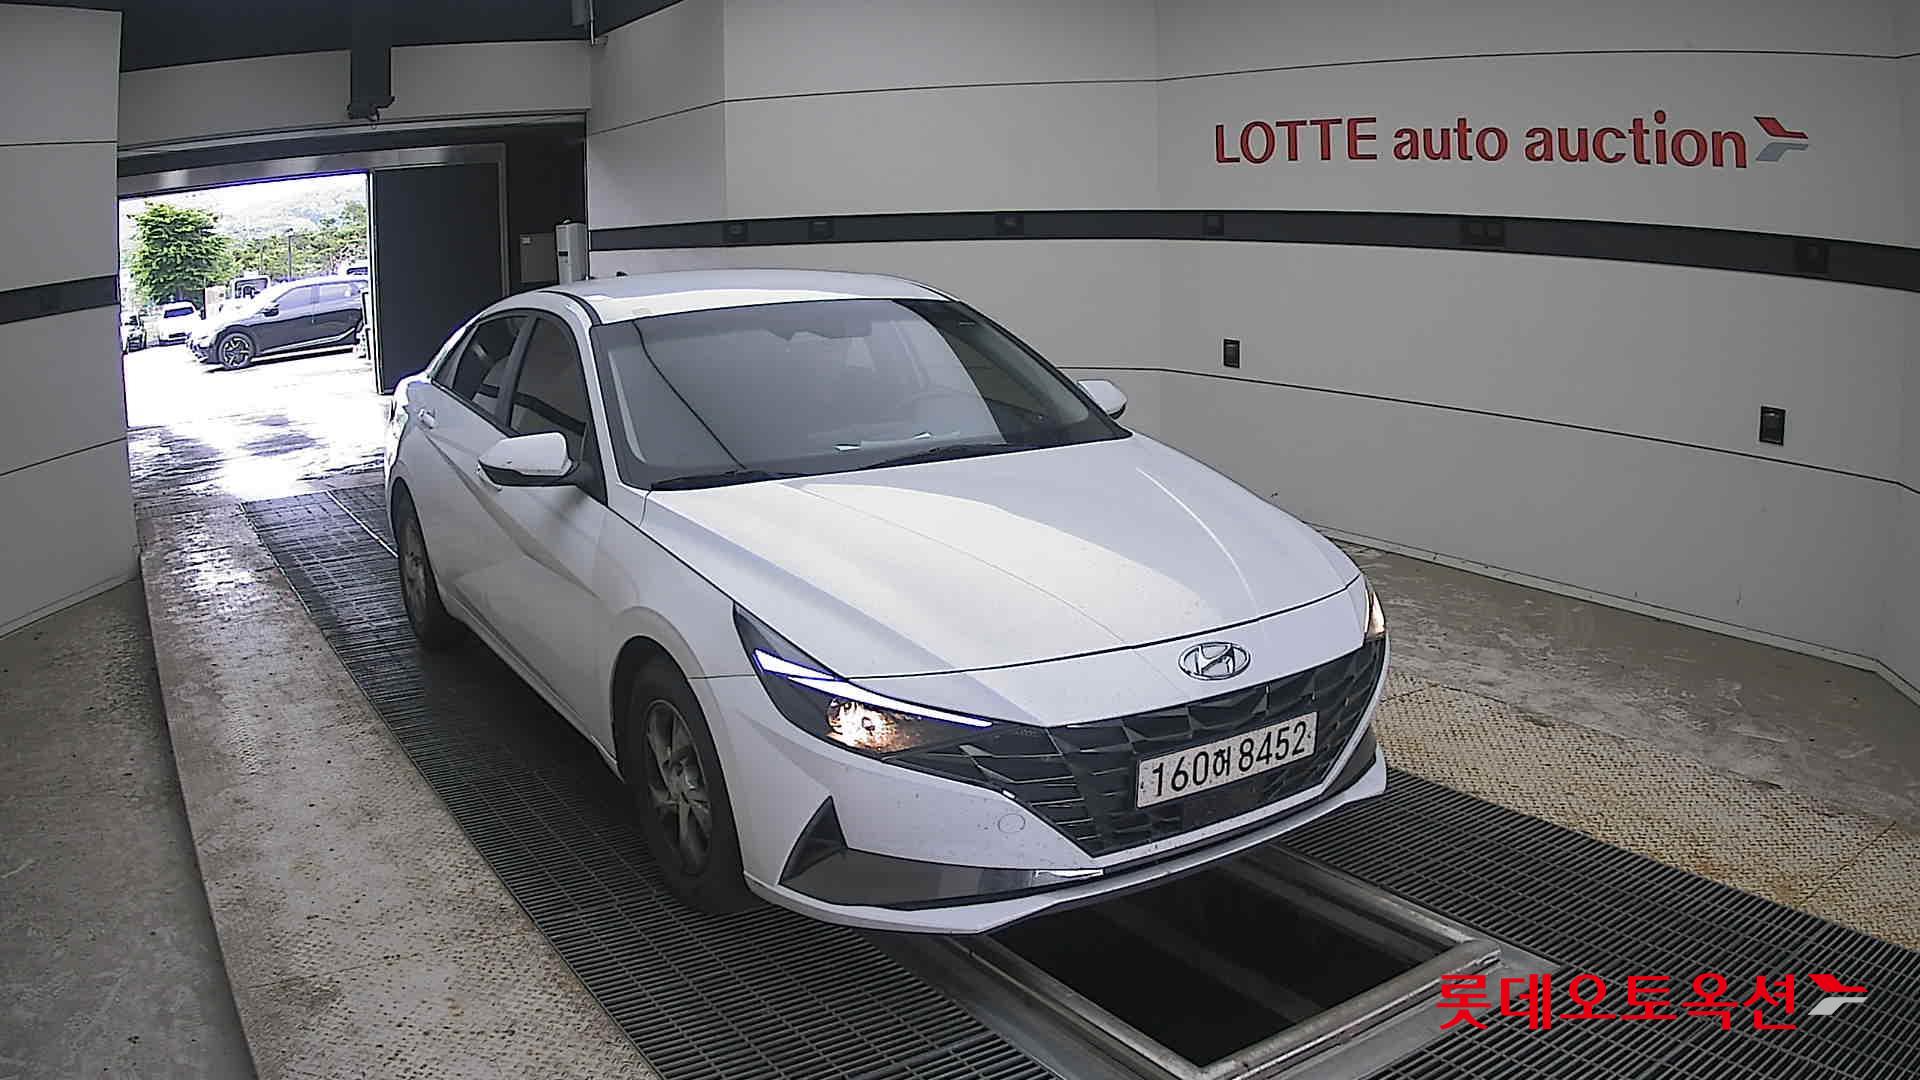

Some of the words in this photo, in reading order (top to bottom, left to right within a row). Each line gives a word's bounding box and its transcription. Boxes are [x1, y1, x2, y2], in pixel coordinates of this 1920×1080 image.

[1215, 117, 1377, 164] LOTTE
[1393, 118, 1508, 162] auto
[1524, 110, 1747, 168] auction
